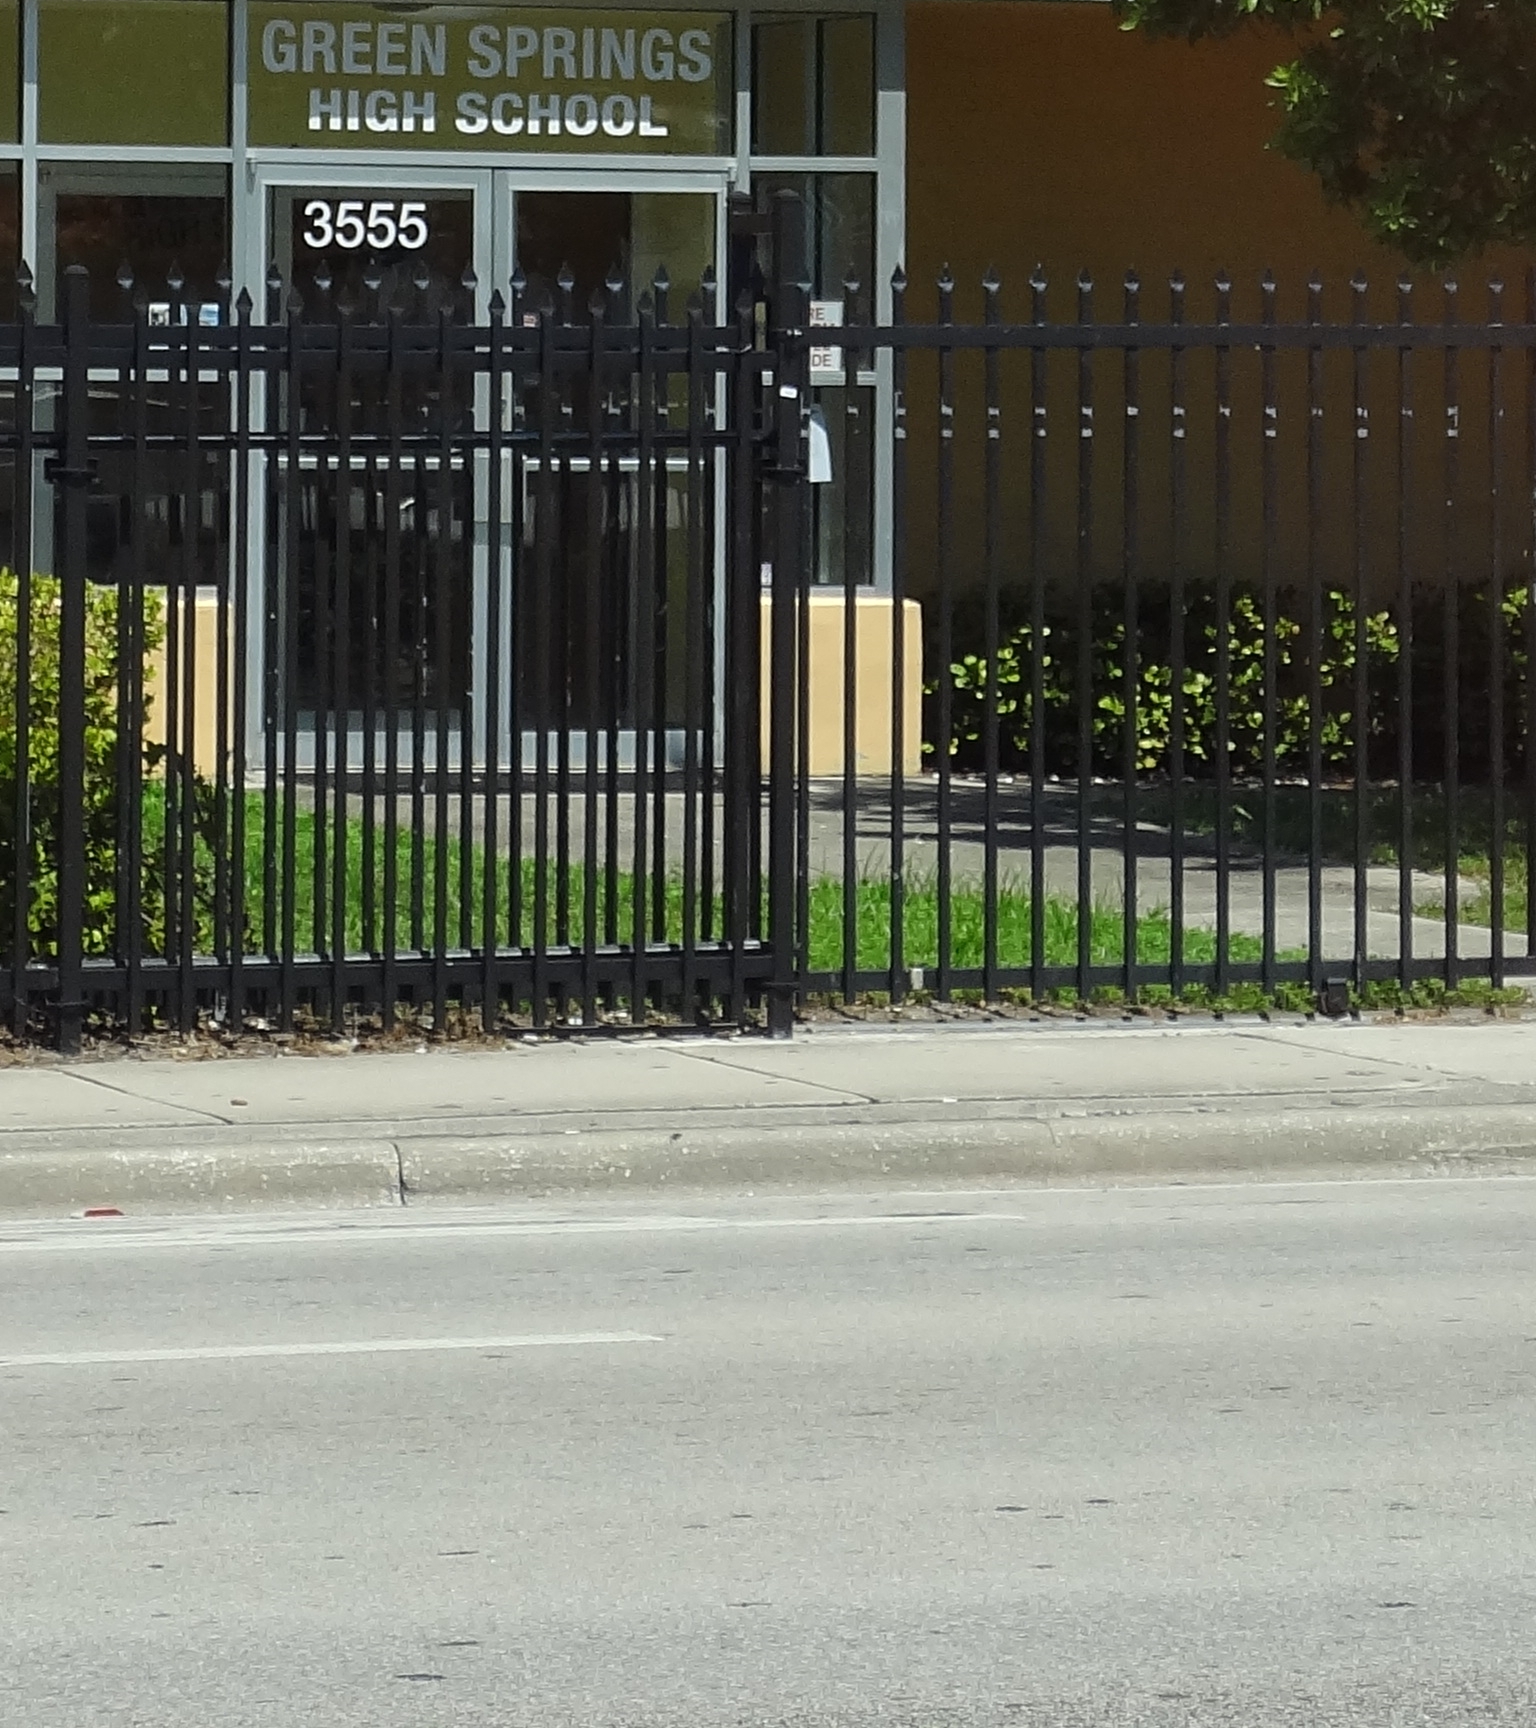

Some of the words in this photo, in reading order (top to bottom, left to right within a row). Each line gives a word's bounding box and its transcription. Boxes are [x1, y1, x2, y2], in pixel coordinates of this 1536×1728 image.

[262, 19, 447, 76] GREEN
[467, 23, 713, 82] SPRINGS
[308, 88, 437, 133] HIGH
[455, 91, 669, 137] SCHOOL
[302, 200, 429, 249] 3555
